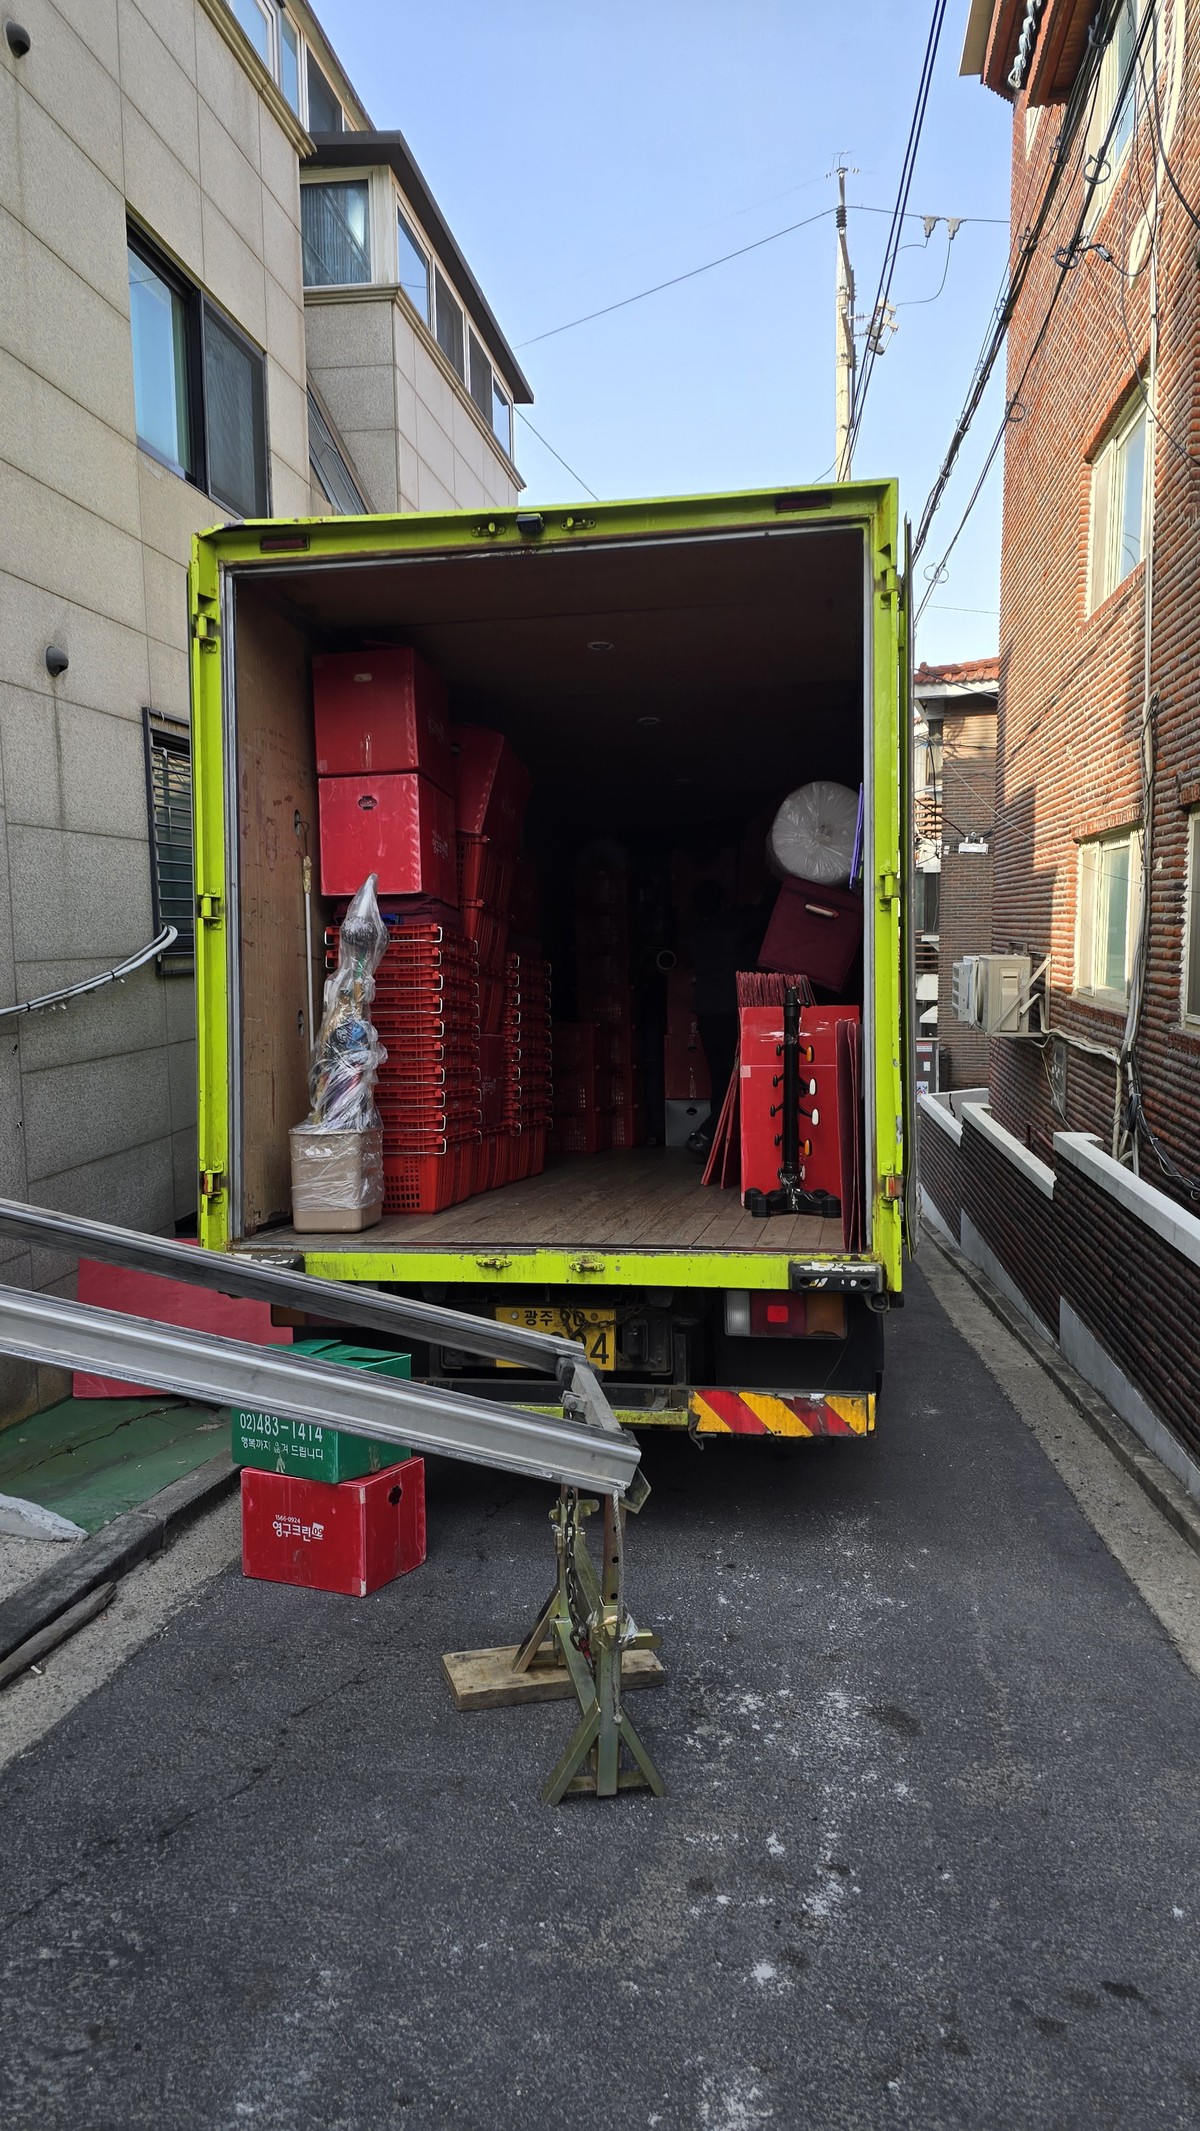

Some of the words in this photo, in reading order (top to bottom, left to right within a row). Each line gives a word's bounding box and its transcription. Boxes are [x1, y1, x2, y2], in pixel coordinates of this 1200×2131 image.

[524, 1310, 553, 1326] 광주
[240, 1413, 323, 1443] 02)483-1414
[240, 1436, 271, 1451] 행복까지
[275, 1514, 301, 1524] 1566-0924
